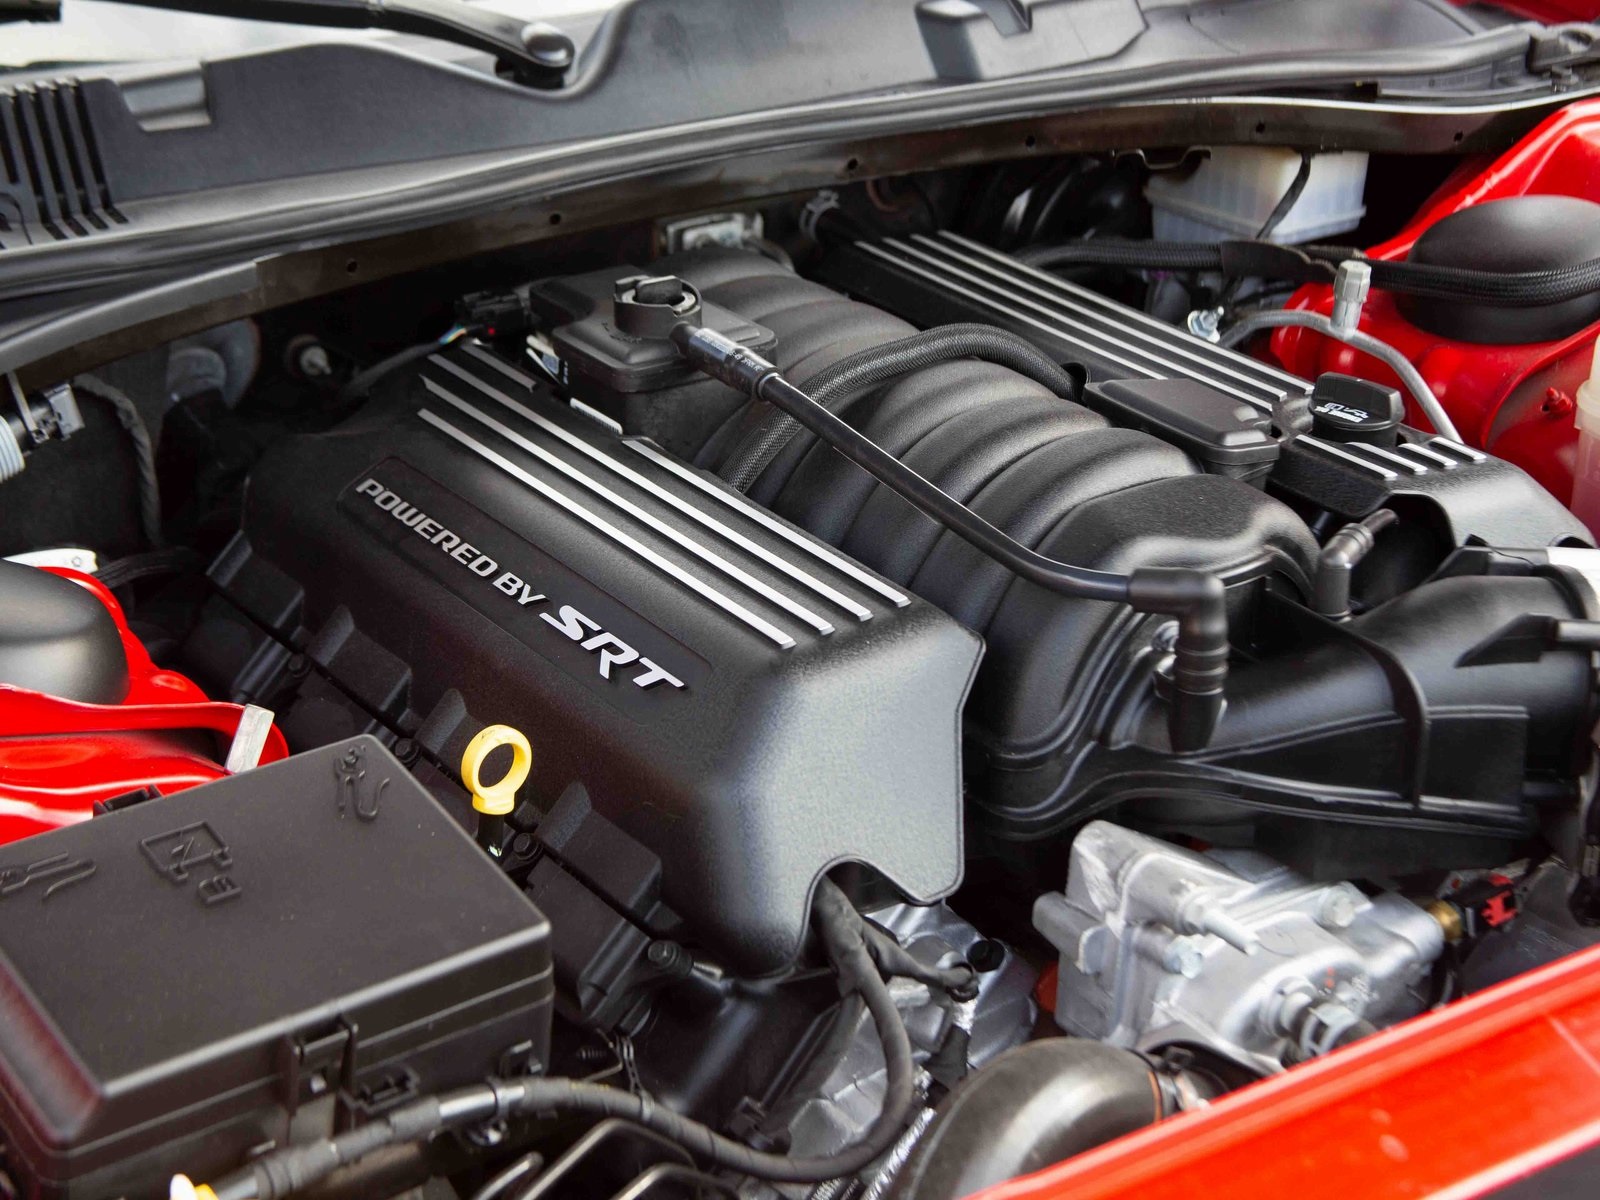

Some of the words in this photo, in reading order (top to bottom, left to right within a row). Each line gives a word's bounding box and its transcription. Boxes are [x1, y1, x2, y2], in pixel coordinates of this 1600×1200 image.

[355, 478, 499, 577] POWERED
[492, 572, 546, 605] BY
[538, 604, 685, 687] SRT
